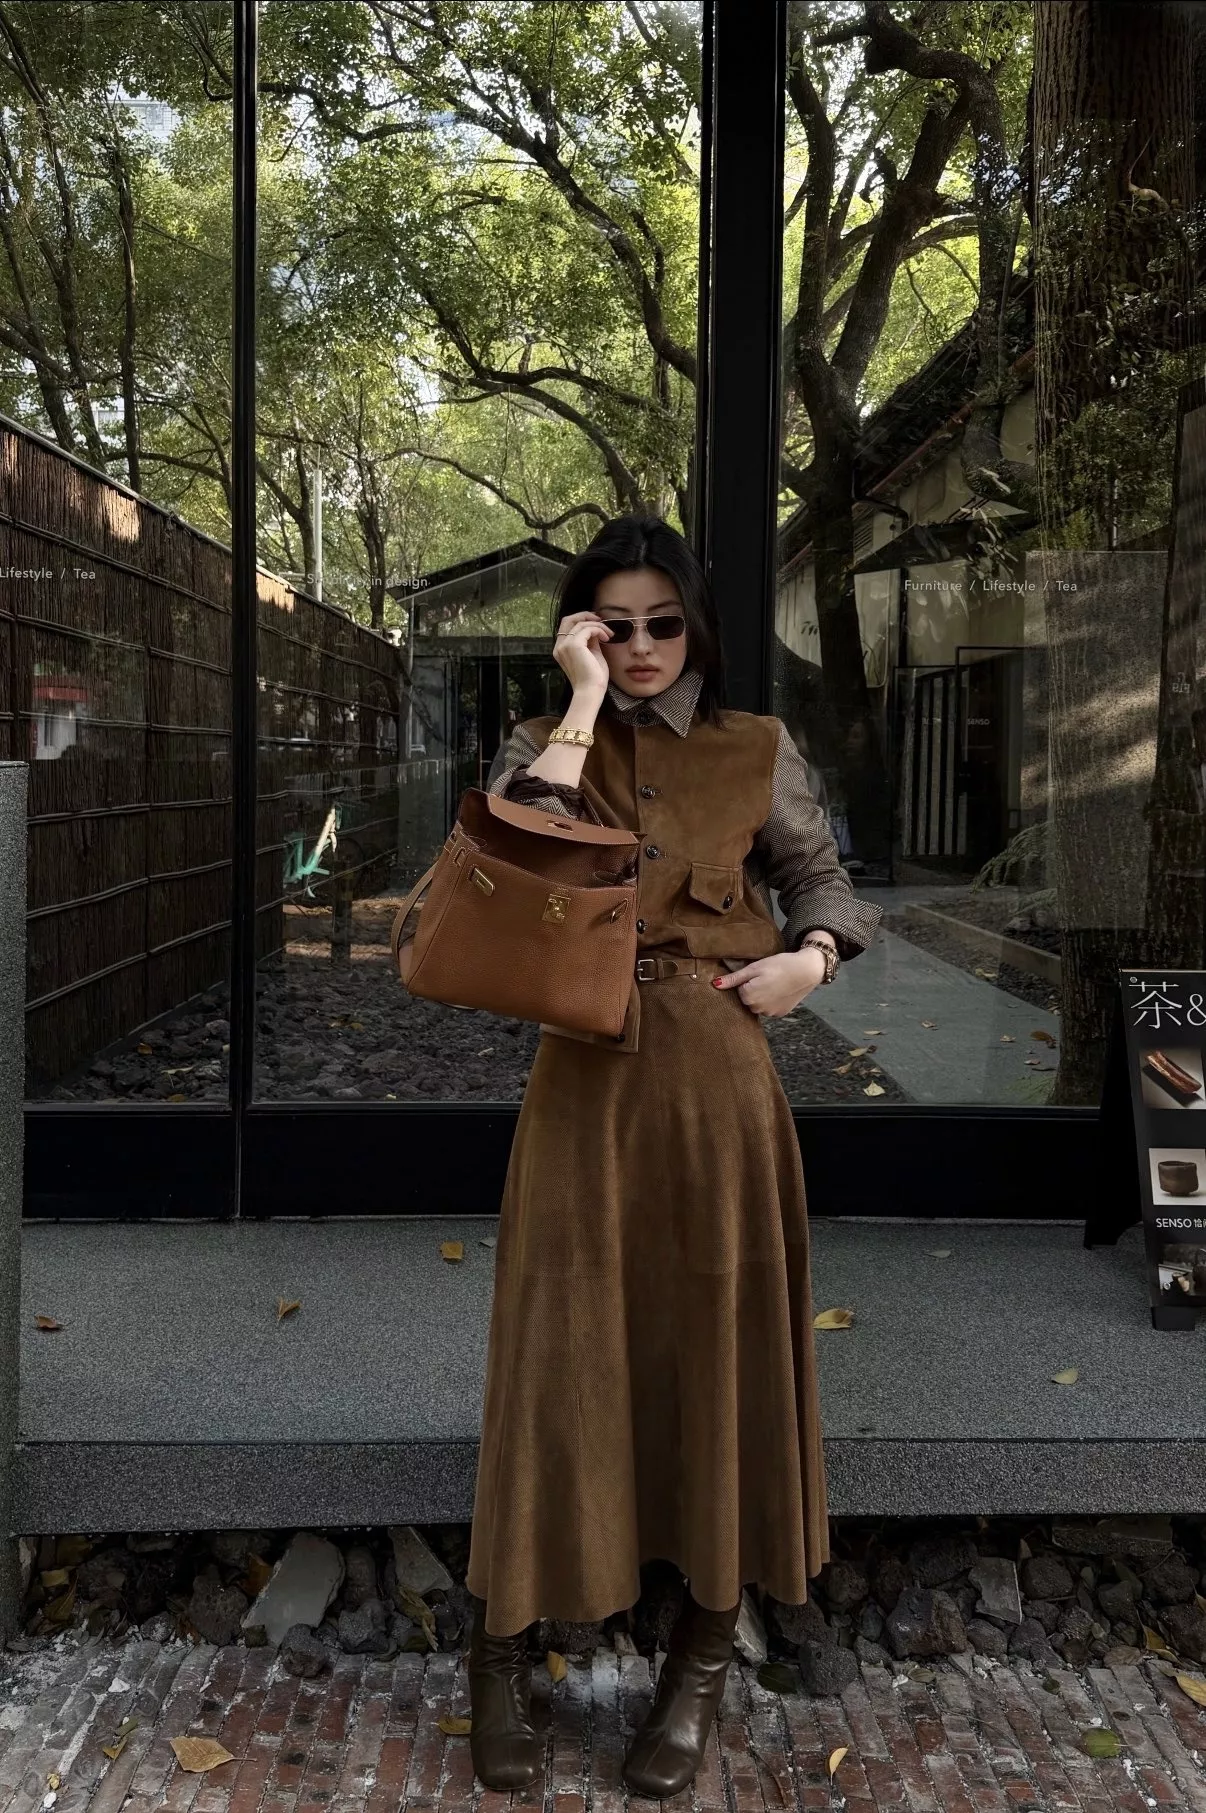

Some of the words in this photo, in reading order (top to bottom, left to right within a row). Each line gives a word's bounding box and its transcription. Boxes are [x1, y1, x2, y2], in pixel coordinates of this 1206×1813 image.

[0, 566, 53, 582] Lifestyle
[60, 567, 66, 580] /
[73, 568, 96, 580] Tea
[371, 576, 382, 586] in
[386, 575, 428, 589] design
[904, 580, 963, 592] Furniture
[969, 580, 976, 592] /
[983, 580, 1036, 594] Lifestyle
[1043, 580, 1049, 592] /
[1056, 581, 1078, 592] Tea
[1155, 1217, 1192, 1228] SENSO
